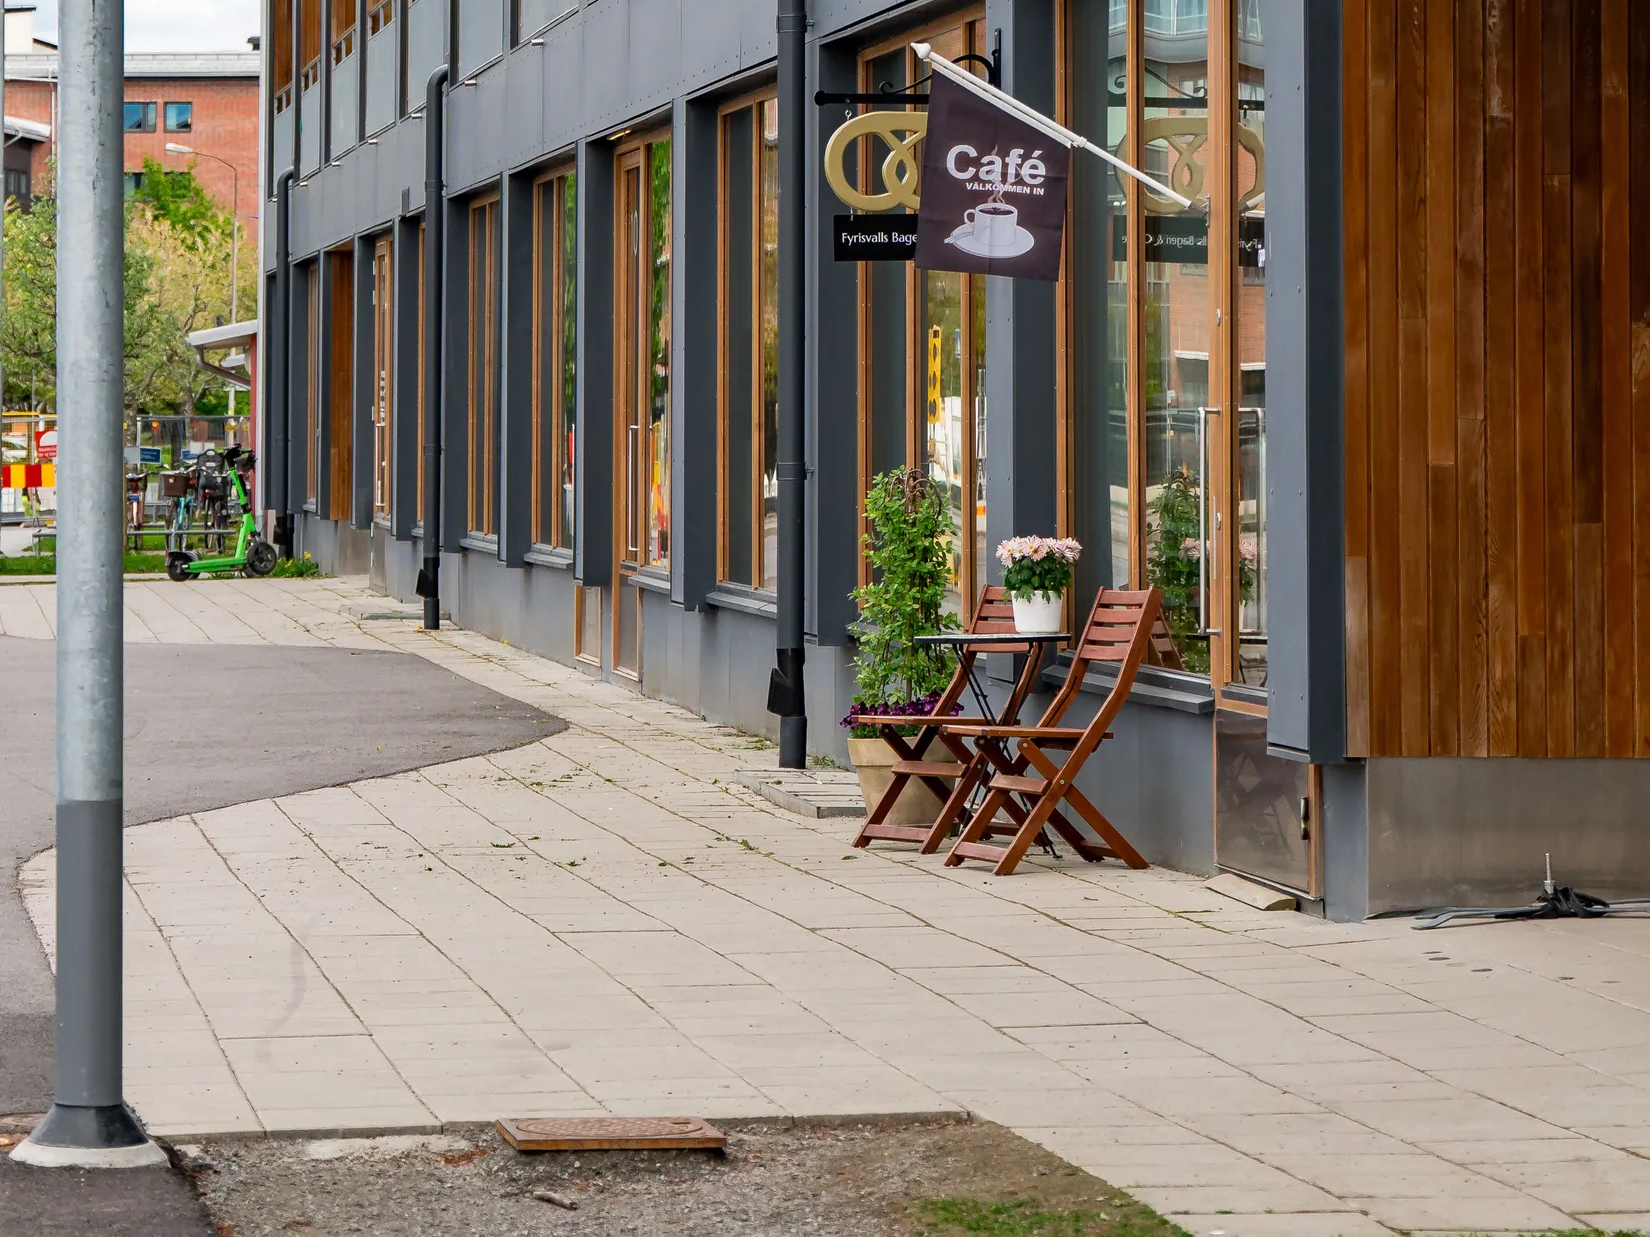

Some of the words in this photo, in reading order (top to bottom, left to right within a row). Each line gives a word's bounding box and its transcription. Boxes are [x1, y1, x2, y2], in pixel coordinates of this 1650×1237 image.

[946, 145, 1046, 185] Café
[966, 182, 1030, 195] VÄLKOMMEN
[1033, 188, 1045, 196] IN
[841, 232, 889, 246] Fyrisvalls
